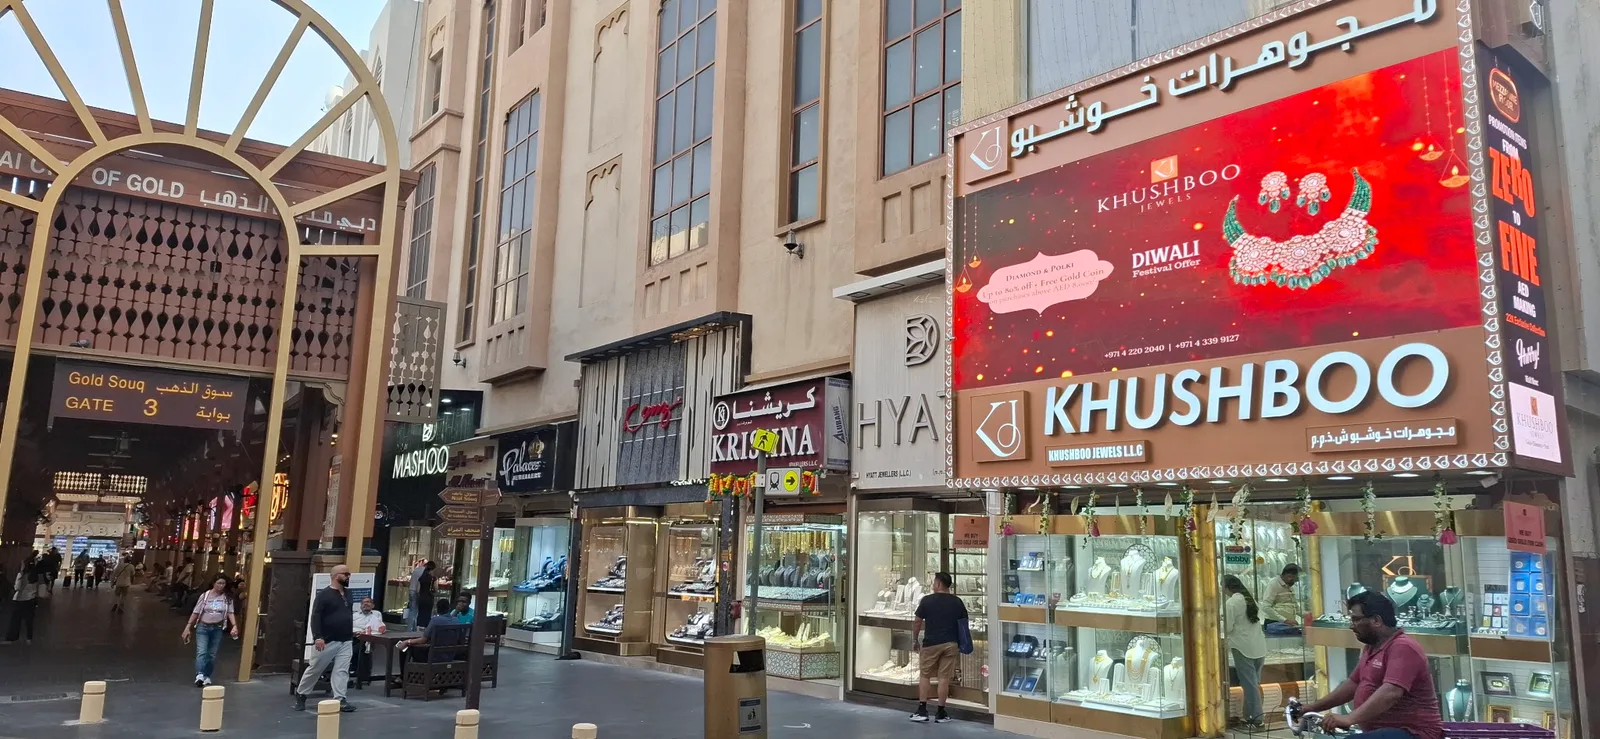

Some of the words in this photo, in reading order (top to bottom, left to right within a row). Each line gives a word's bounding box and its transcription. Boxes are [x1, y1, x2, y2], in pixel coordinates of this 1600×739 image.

[1011, 75, 1160, 157] خوشبو
[1502, 138, 1519, 160] FROM
[91, 167, 121, 187] OF
[127, 173, 184, 198] GOLD
[1098, 164, 1240, 213] KHUSHBOO
[1488, 146, 1536, 217] ZERO
[200, 190, 268, 213] الذهب
[1140, 193, 1191, 213] JEWELS
[336, 217, 376, 231] دبي
[1512, 210, 1521, 226] TO
[1132, 239, 1200, 269] DIWALI
[1498, 220, 1540, 286] FIVE
[1132, 263, 1172, 278] Festival
[1174, 259, 1201, 270] Offer
[995, 289, 1003, 297] to
[1021, 281, 1033, 291] off
[1041, 278, 1058, 287] Free
[1060, 271, 1081, 282] Gold
[1083, 268, 1104, 278] Coin
[1517, 281, 1529, 298] AED
[1000, 292, 1030, 304] purchases
[1032, 288, 1051, 297] above
[1513, 295, 1537, 318] MAKING
[1104, 350, 1120, 358] +971
[1128, 348, 1143, 356] 220
[1144, 344, 1165, 354] 2040
[1175, 340, 1193, 349] +971
[1202, 337, 1218, 346] 339
[1220, 334, 1239, 343] 9127
[69, 371, 104, 387] Gold
[108, 375, 145, 393] Souq
[156, 381, 199, 395] الذهب
[201, 384, 233, 400] سوق
[1044, 342, 1449, 436] KHUSHBOO
[65, 396, 114, 412] GATE
[143, 398, 158, 417] 3
[732, 386, 815, 420] كريشنا
[195, 405, 231, 423] بوابة
[1516, 412, 1554, 434] KHUSHBOO
[1350, 426, 1392, 443] خوشبو
[1393, 426, 1455, 440] مجوهرات
[1048, 447, 1091, 461] KHUSHBOO
[1092, 445, 1123, 459] JEWELS
[878, 470, 898, 478] JEWELLERS
[1227, 555, 1249, 563] tabby
